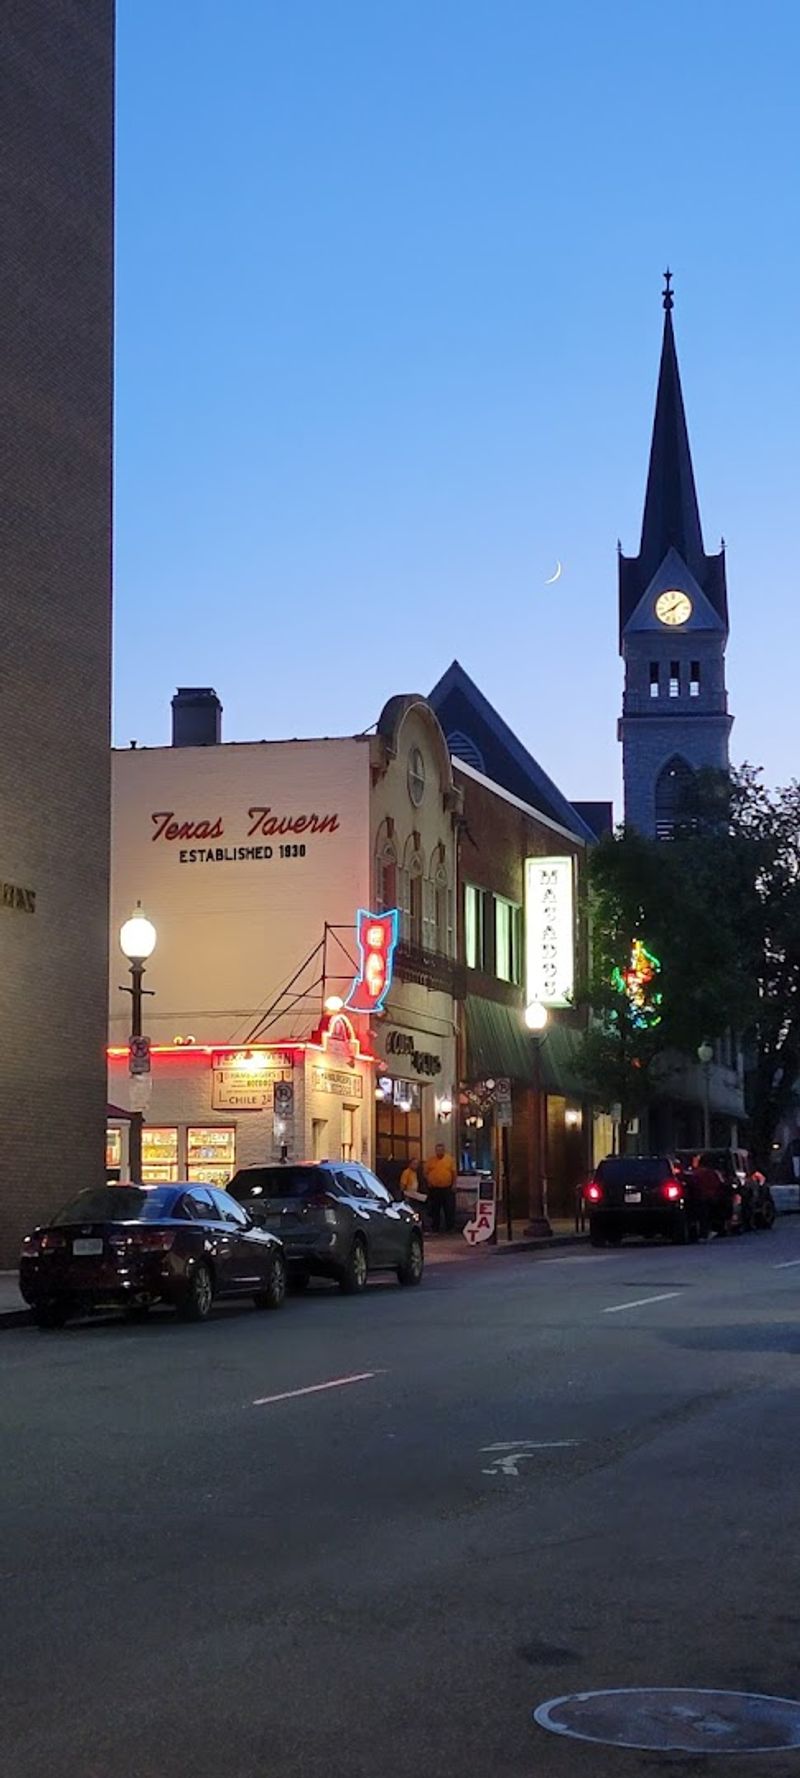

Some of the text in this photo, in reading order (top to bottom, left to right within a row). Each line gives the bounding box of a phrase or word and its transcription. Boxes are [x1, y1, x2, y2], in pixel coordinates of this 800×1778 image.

[151, 806, 341, 842] Texas Tavern
[179, 844, 307, 863] ESTABLISHED 1930
[366, 925, 386, 997] EAT
[228, 1096, 257, 1105] CHILE
[467, 1202, 492, 1243] EAT
